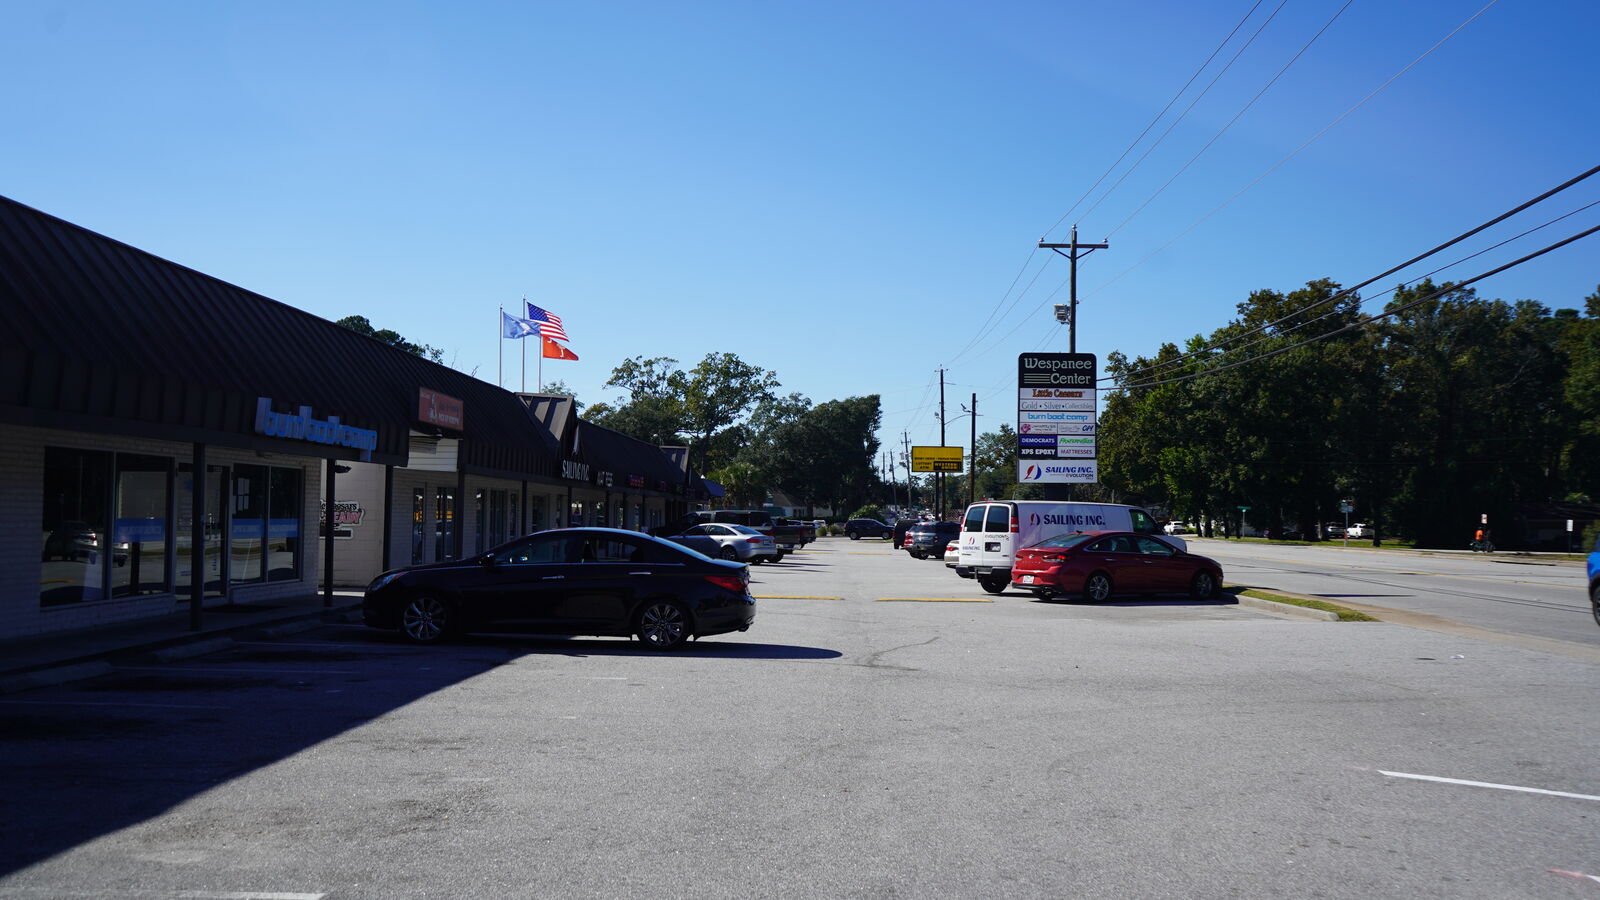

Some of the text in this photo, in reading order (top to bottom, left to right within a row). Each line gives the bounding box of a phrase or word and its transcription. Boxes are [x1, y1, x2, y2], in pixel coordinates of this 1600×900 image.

[1024, 358, 1092, 371] Wespanee
[1050, 373, 1091, 384] Center
[1032, 388, 1083, 398] Little Caesars
[1021, 401, 1094, 410] Gold Silver Collectibles
[254, 397, 302, 441] burn
[299, 405, 341, 446] boot
[1066, 414, 1088, 422] camp
[1043, 514, 1106, 526] SAILING INC.
